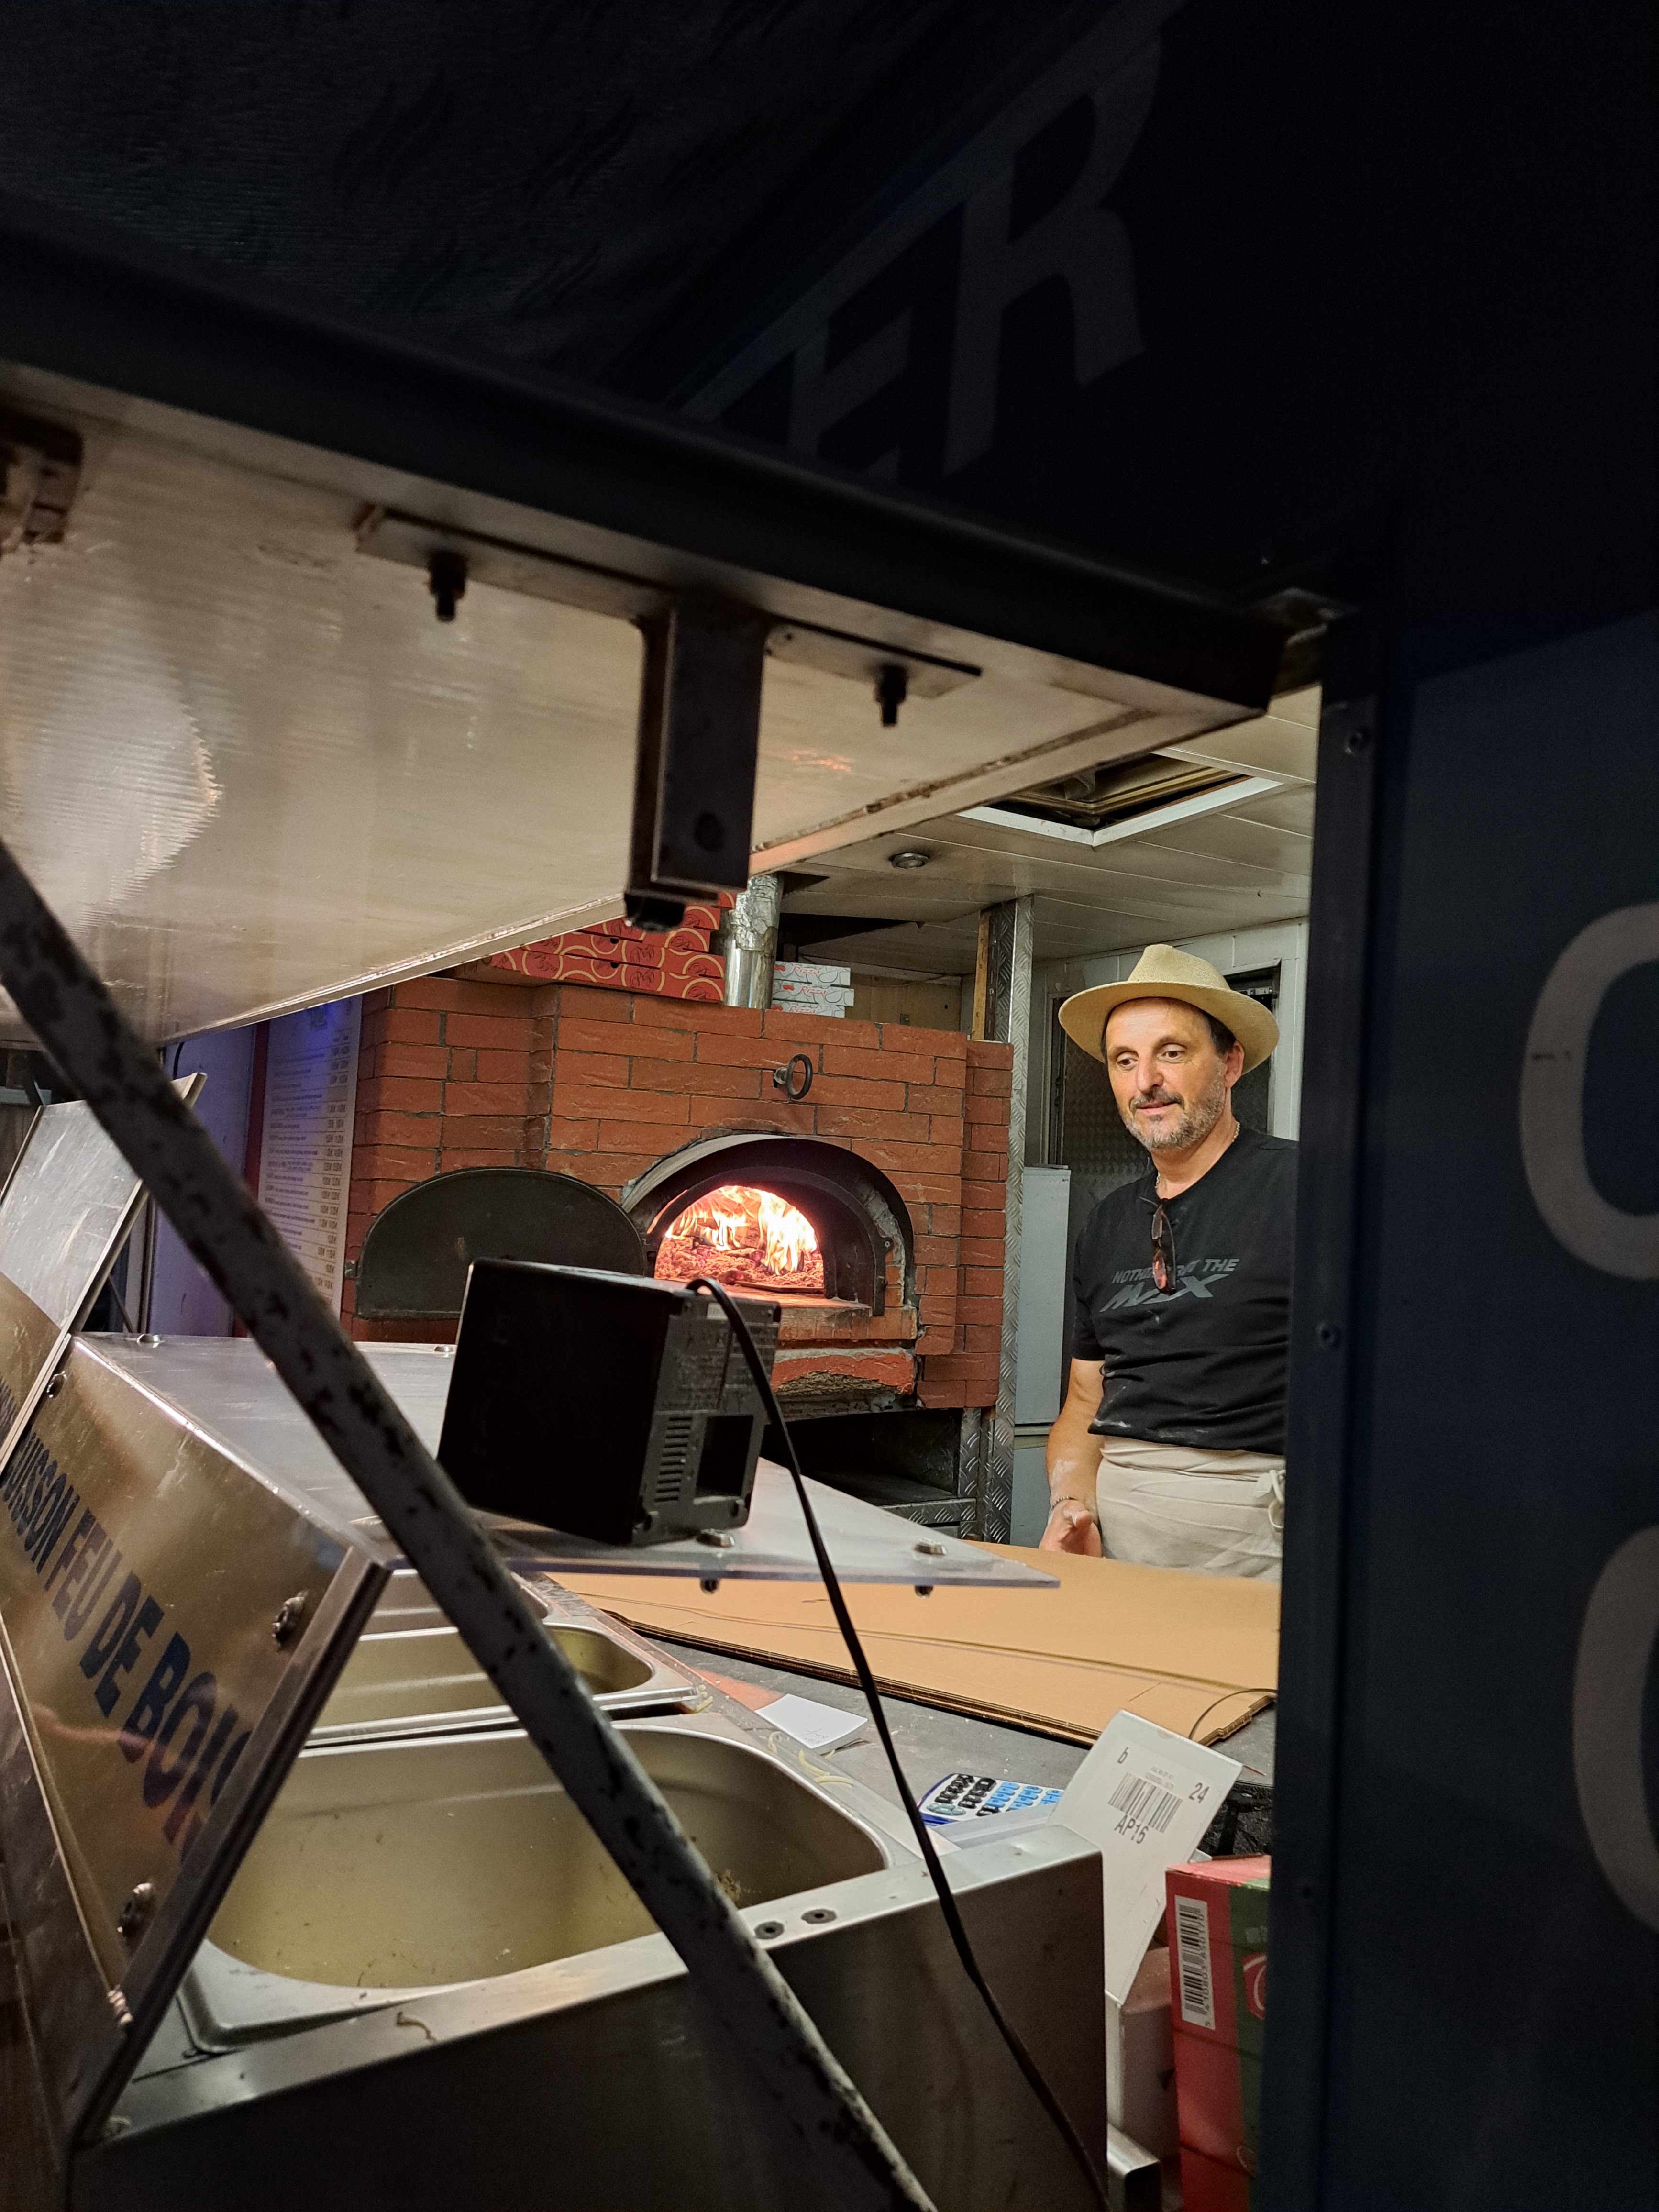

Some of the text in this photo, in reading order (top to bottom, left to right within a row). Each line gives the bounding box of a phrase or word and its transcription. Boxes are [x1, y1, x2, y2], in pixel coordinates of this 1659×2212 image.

[1202, 1258, 1240, 1272] THE
[44, 1507, 123, 1641] FEU
[79, 1569, 165, 1718] DE
[1188, 1782, 1210, 1804] 24
[1114, 1814, 1149, 1844] AP16
